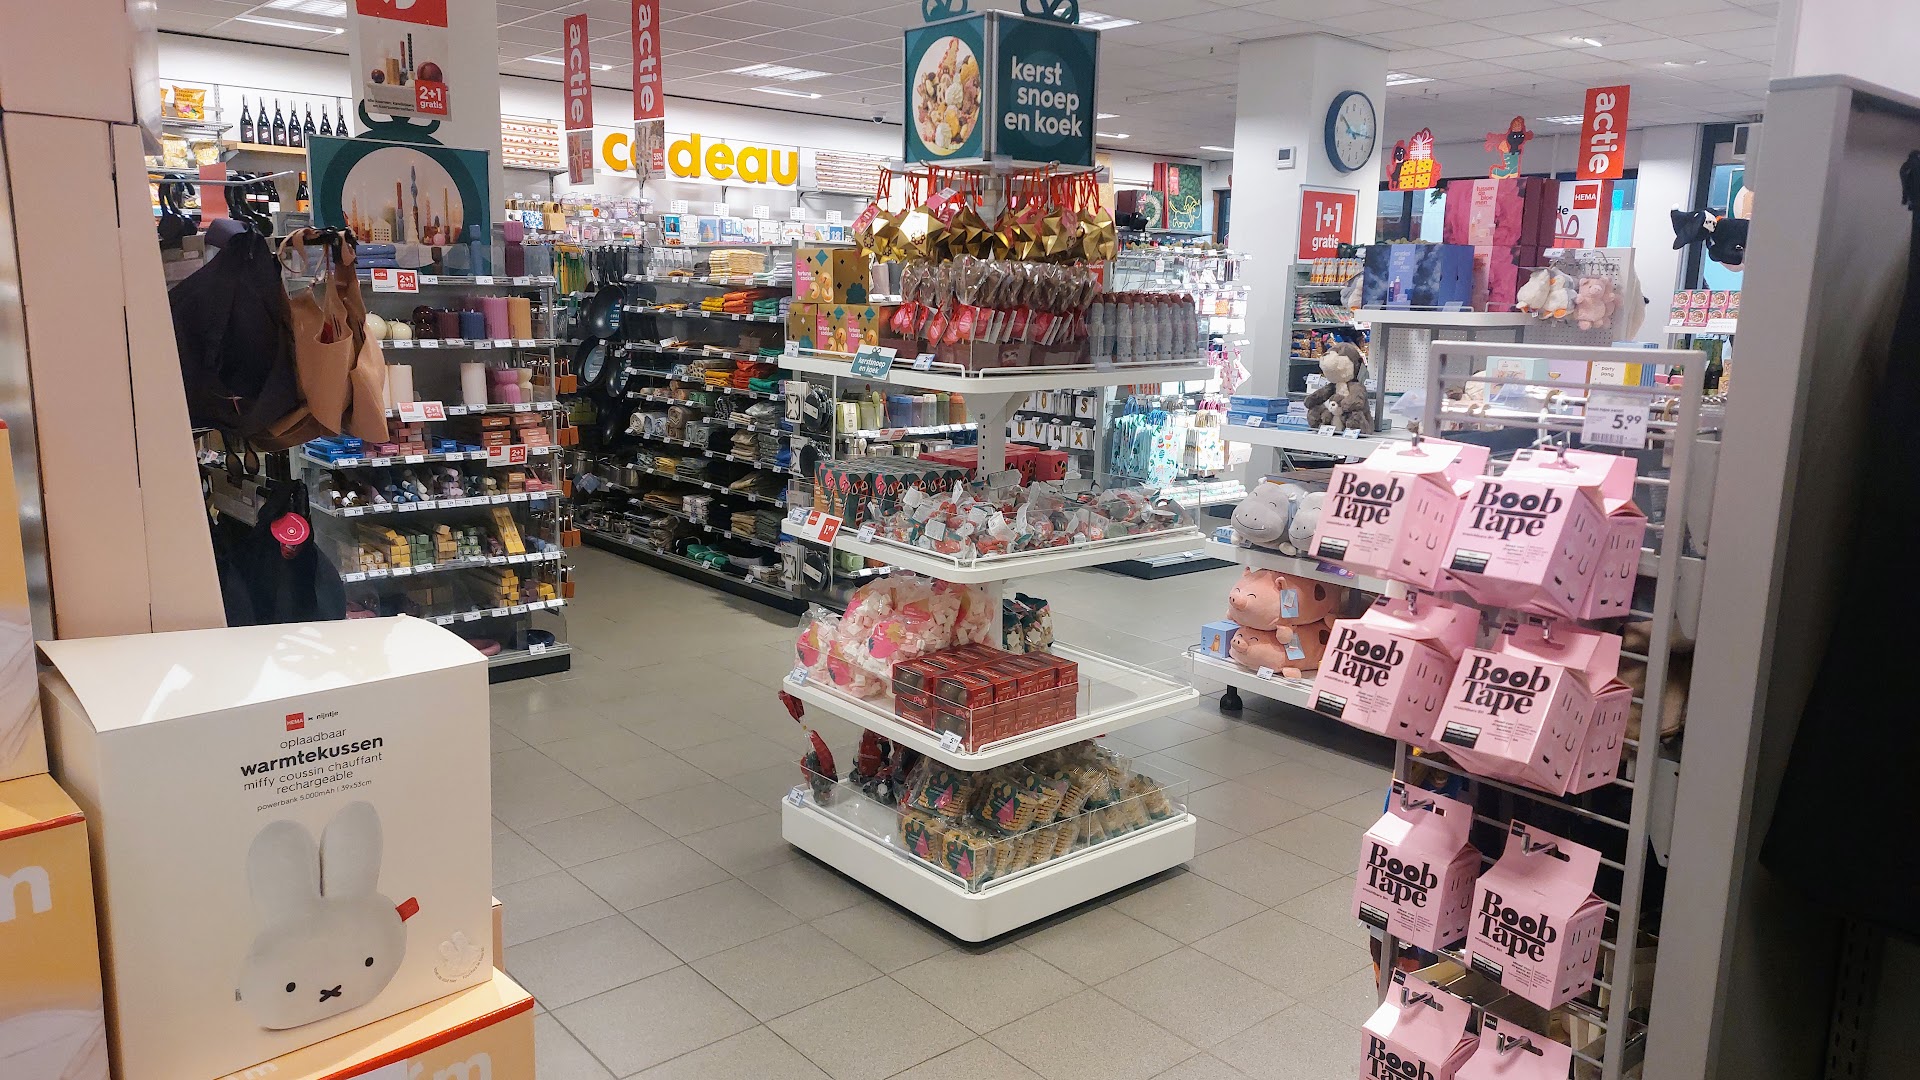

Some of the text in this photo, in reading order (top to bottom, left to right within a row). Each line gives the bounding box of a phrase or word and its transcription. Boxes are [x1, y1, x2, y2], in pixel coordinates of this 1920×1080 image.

[569, 23, 588, 123] actie
[638, 3, 658, 112] actie
[1011, 55, 1062, 86] kerst
[419, 86, 442, 101] 2+1
[420, 100, 443, 109] gratis
[1017, 86, 1080, 115] snoep
[1004, 110, 1082, 137] en koek
[1589, 92, 1619, 174] actie
[602, 132, 798, 187] cdeau
[1575, 193, 1597, 201] HEMA
[1315, 201, 1343, 233] 1+1
[1312, 234, 1339, 251] gratis
[400, 275, 414, 283] 2+1
[1612, 414, 1642, 430] 5.99
[511, 449, 524, 457] 2+1
[1337, 471, 1405, 503] Boob
[1477, 482, 1563, 514] Boob
[1331, 495, 1391, 529] Tape
[1470, 506, 1546, 541] Tape
[1334, 627, 1404, 667] Boob
[1329, 651, 1389, 687] Tape
[1468, 655, 1551, 693] Boob
[1461, 680, 1534, 716] Tape
[316, 710, 339, 720] nijntje
[280, 728, 347, 750] oplaadbaar
[240, 736, 384, 777] warmtekussen
[243, 752, 383, 791] miffy coussin chauffant
[276, 770, 354, 795] rechargeable
[256, 796, 298, 812] powerbank
[1369, 841, 1438, 890] Boob
[1366, 863, 1427, 908] Tape
[1481, 889, 1557, 944] Boob
[1478, 911, 1545, 963] Tape
[1368, 1034, 1434, 1080] Boob
